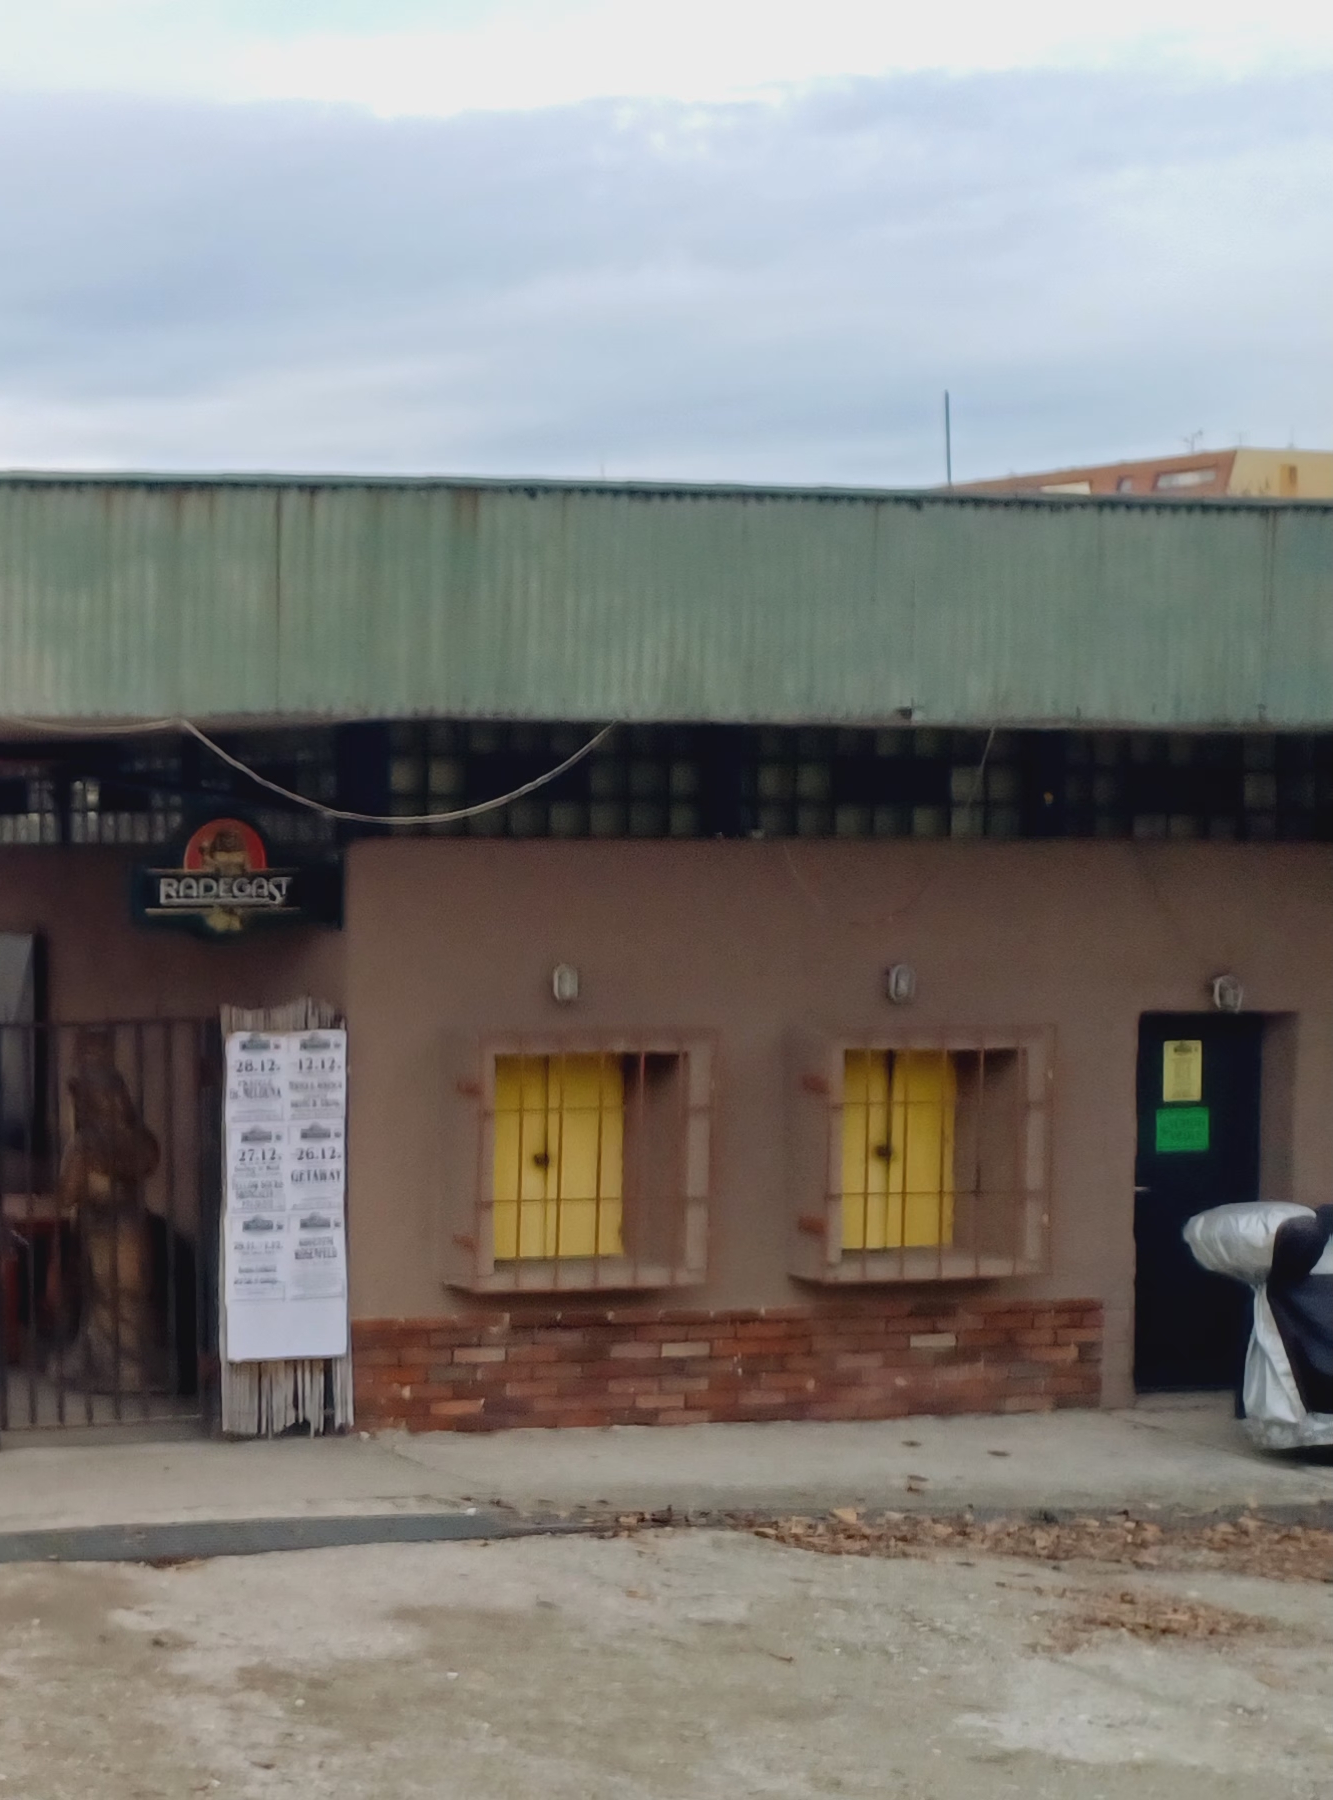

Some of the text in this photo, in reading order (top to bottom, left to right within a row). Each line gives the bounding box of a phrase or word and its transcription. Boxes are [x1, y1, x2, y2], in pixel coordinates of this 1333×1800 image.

[160, 876, 293, 906] RADEGAST
[236, 1059, 281, 1073] 28.12.
[237, 1148, 282, 1162] 27.12.
[290, 1168, 342, 1183] GETAWAY
